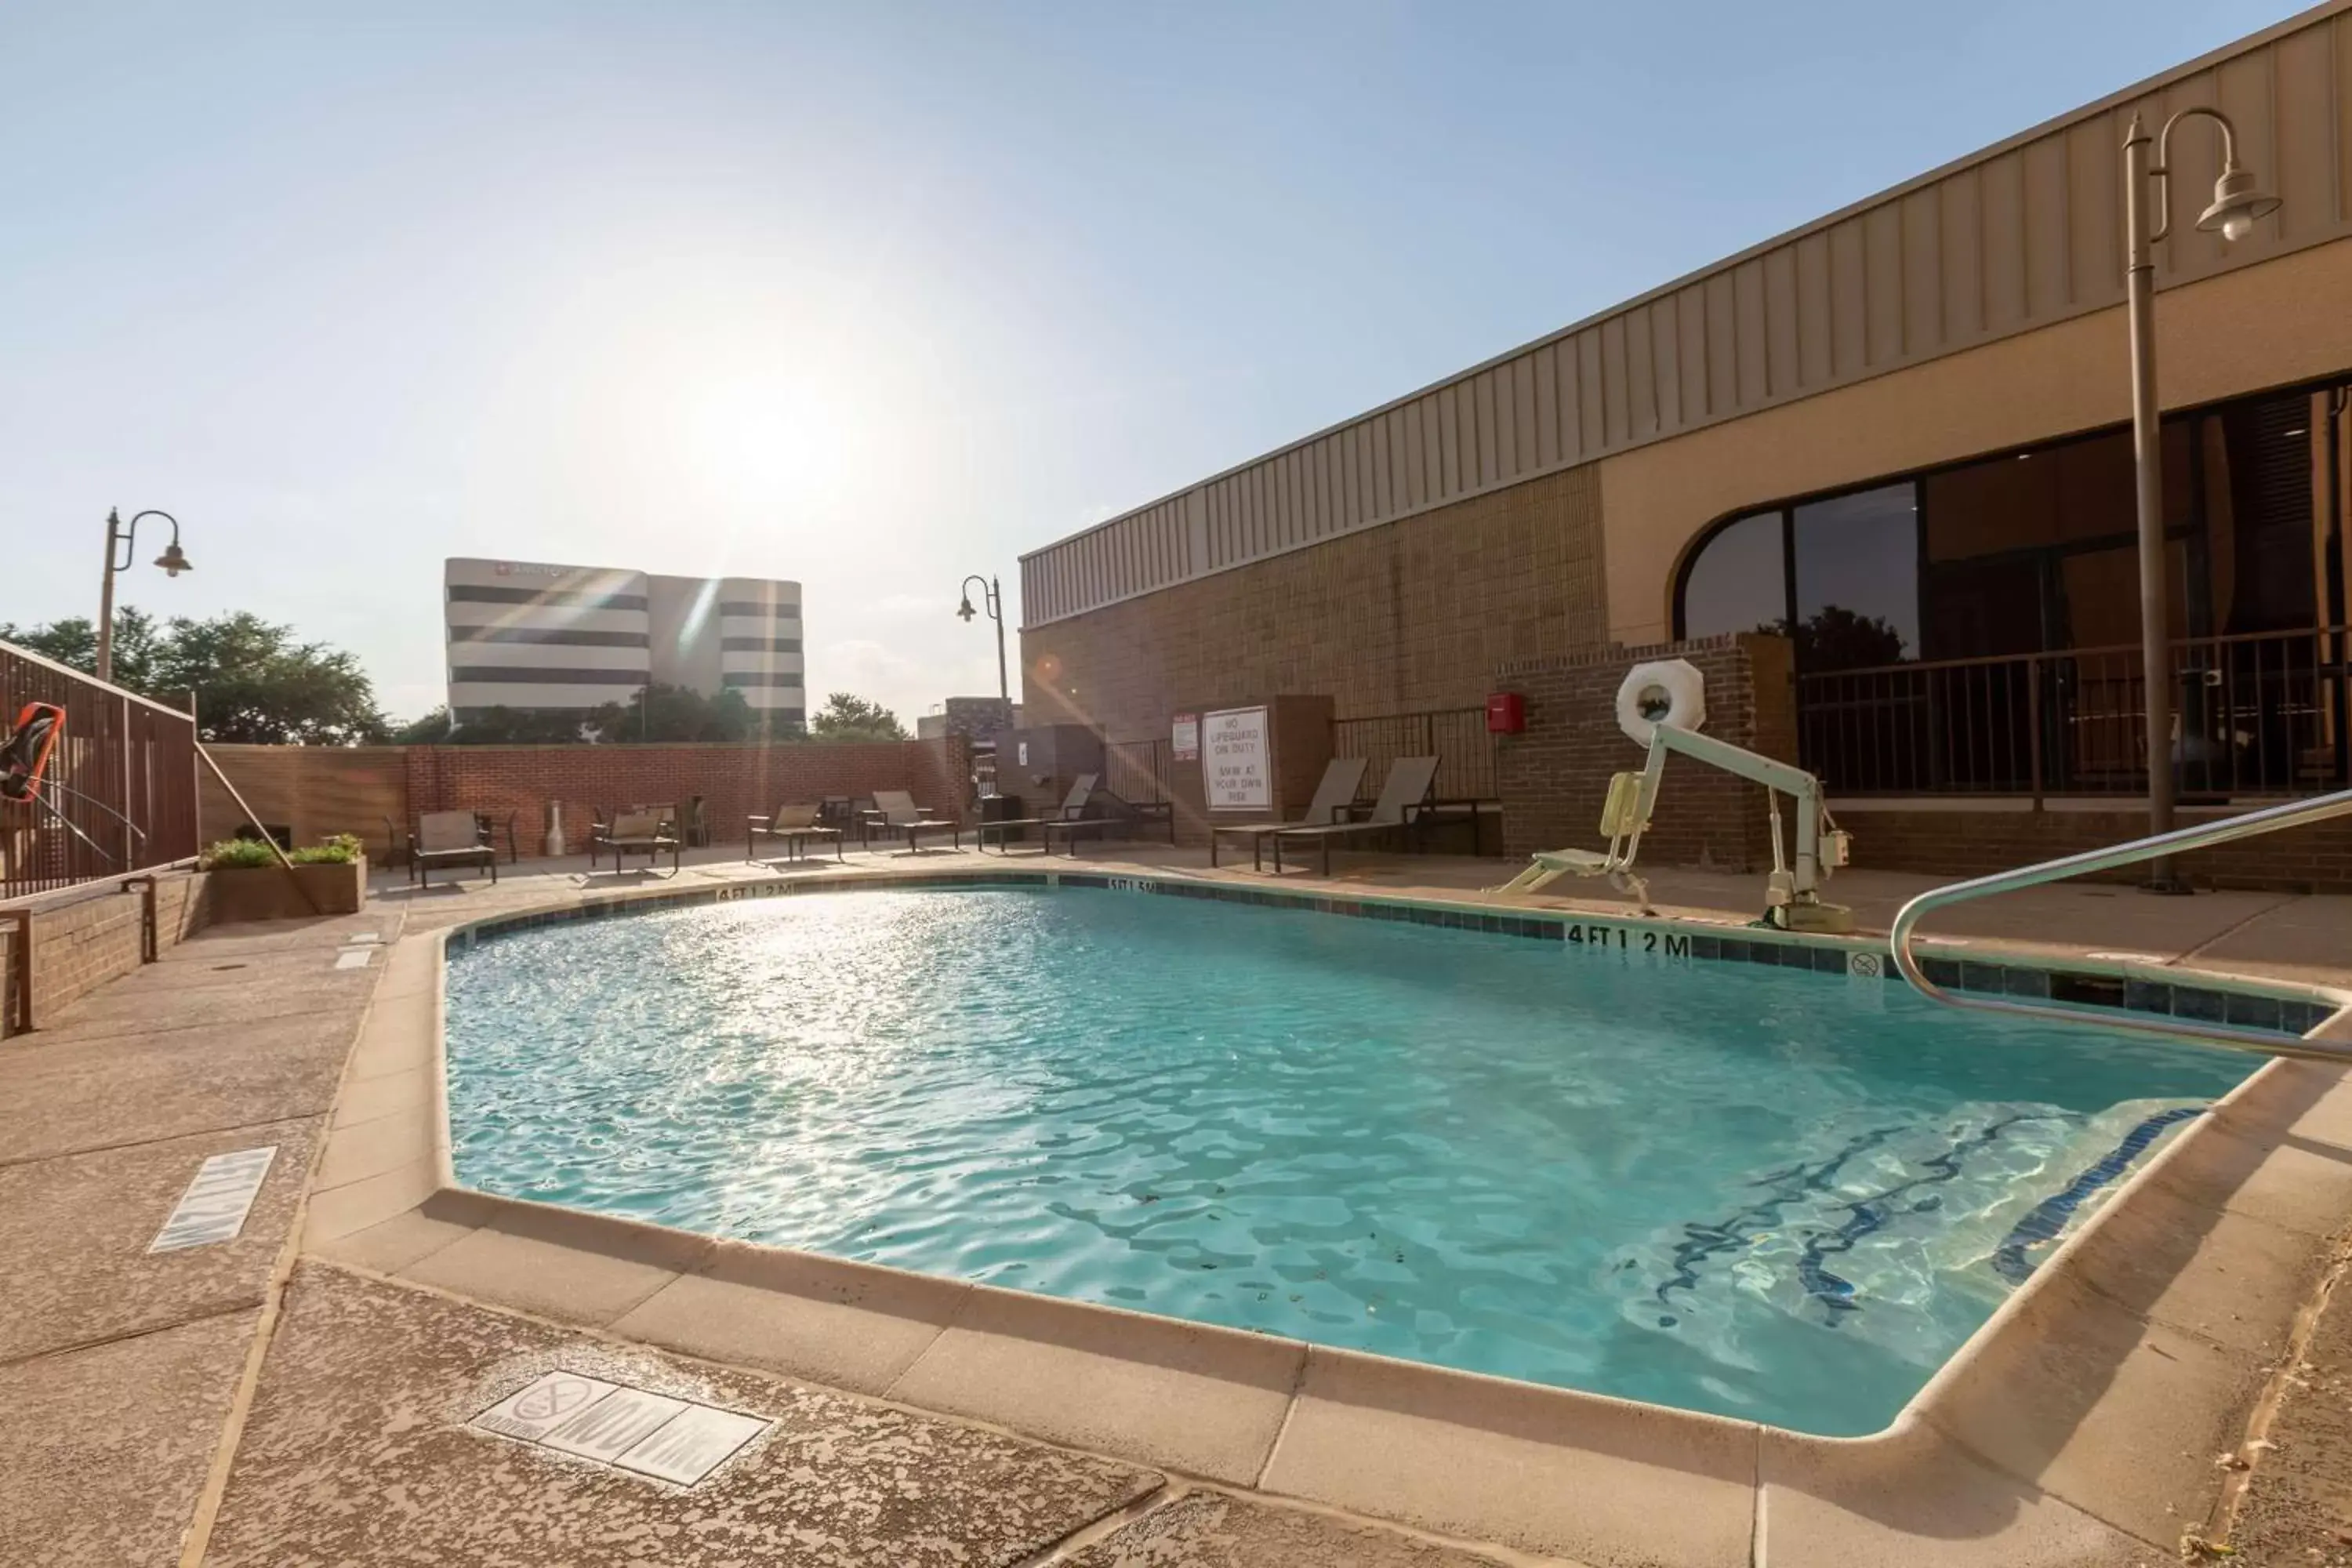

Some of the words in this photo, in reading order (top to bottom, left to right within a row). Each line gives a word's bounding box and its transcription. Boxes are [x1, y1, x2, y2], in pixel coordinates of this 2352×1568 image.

[1225, 718, 1238, 728] NO
[1210, 728, 1258, 743] LIFEGUARD
[1215, 745, 1229, 755] ON
[1232, 742, 1255, 753] DUTY
[1214, 779, 1236, 789] YOUR
[1241, 778, 1261, 788] OWN
